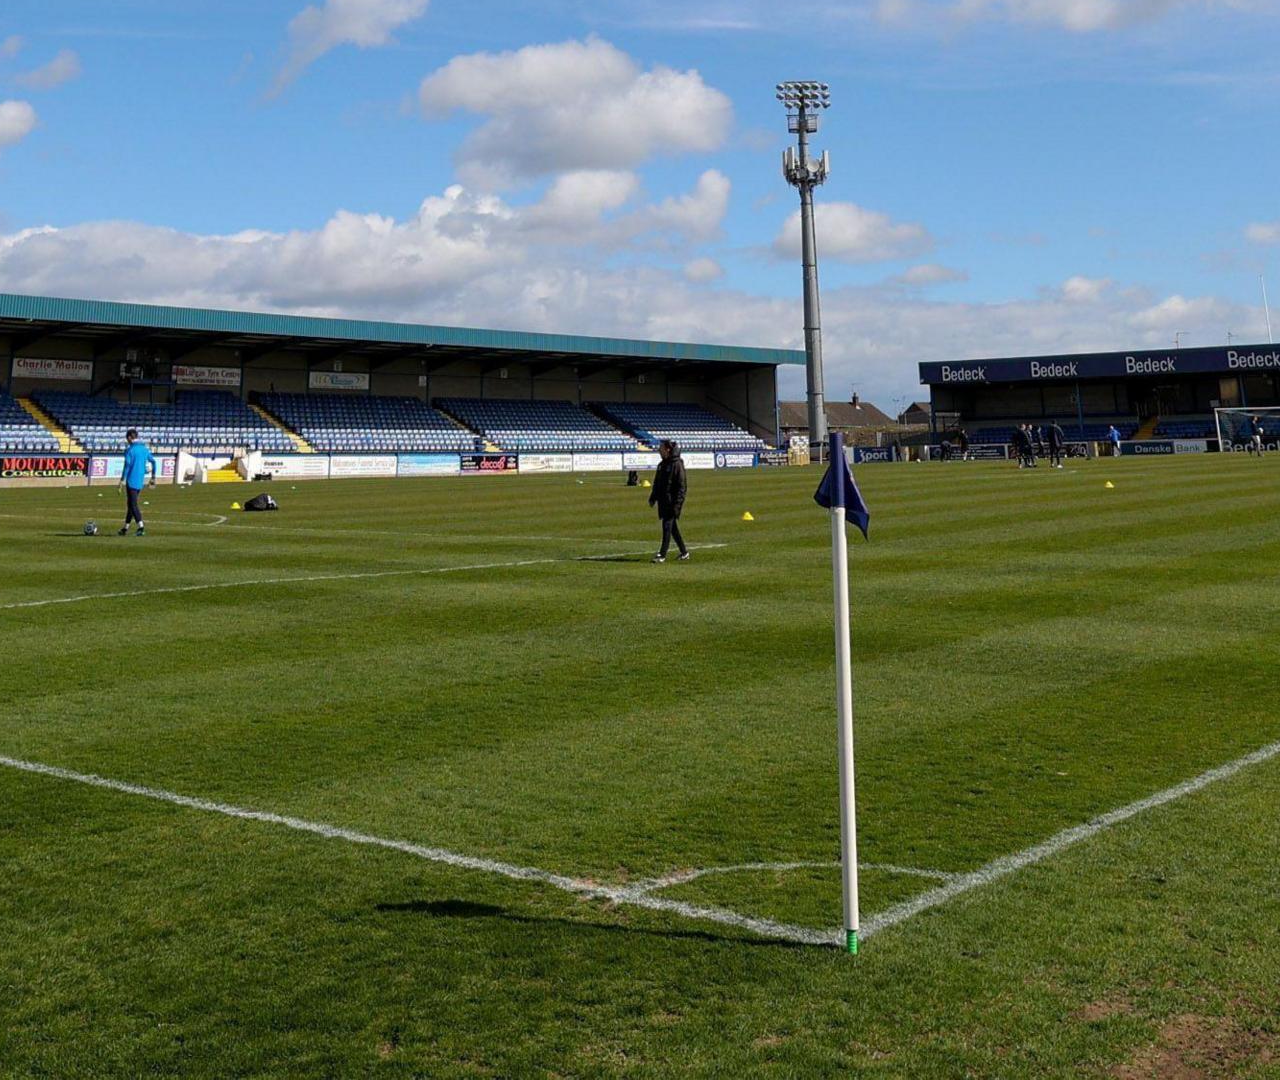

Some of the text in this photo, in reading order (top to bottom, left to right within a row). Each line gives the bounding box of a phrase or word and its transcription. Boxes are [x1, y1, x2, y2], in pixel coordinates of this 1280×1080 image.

[16, 359, 53, 369] Charlie
[1031, 361, 1079, 378] Bedeck
[1125, 356, 1176, 374] Bedeck
[942, 366, 986, 382] Bedeck
[1135, 444, 1171, 454] Danske
[1175, 443, 1201, 453] Bank
[2, 457, 85, 470] MOUTRAY'S
[2, 469, 85, 478] Costcutters
